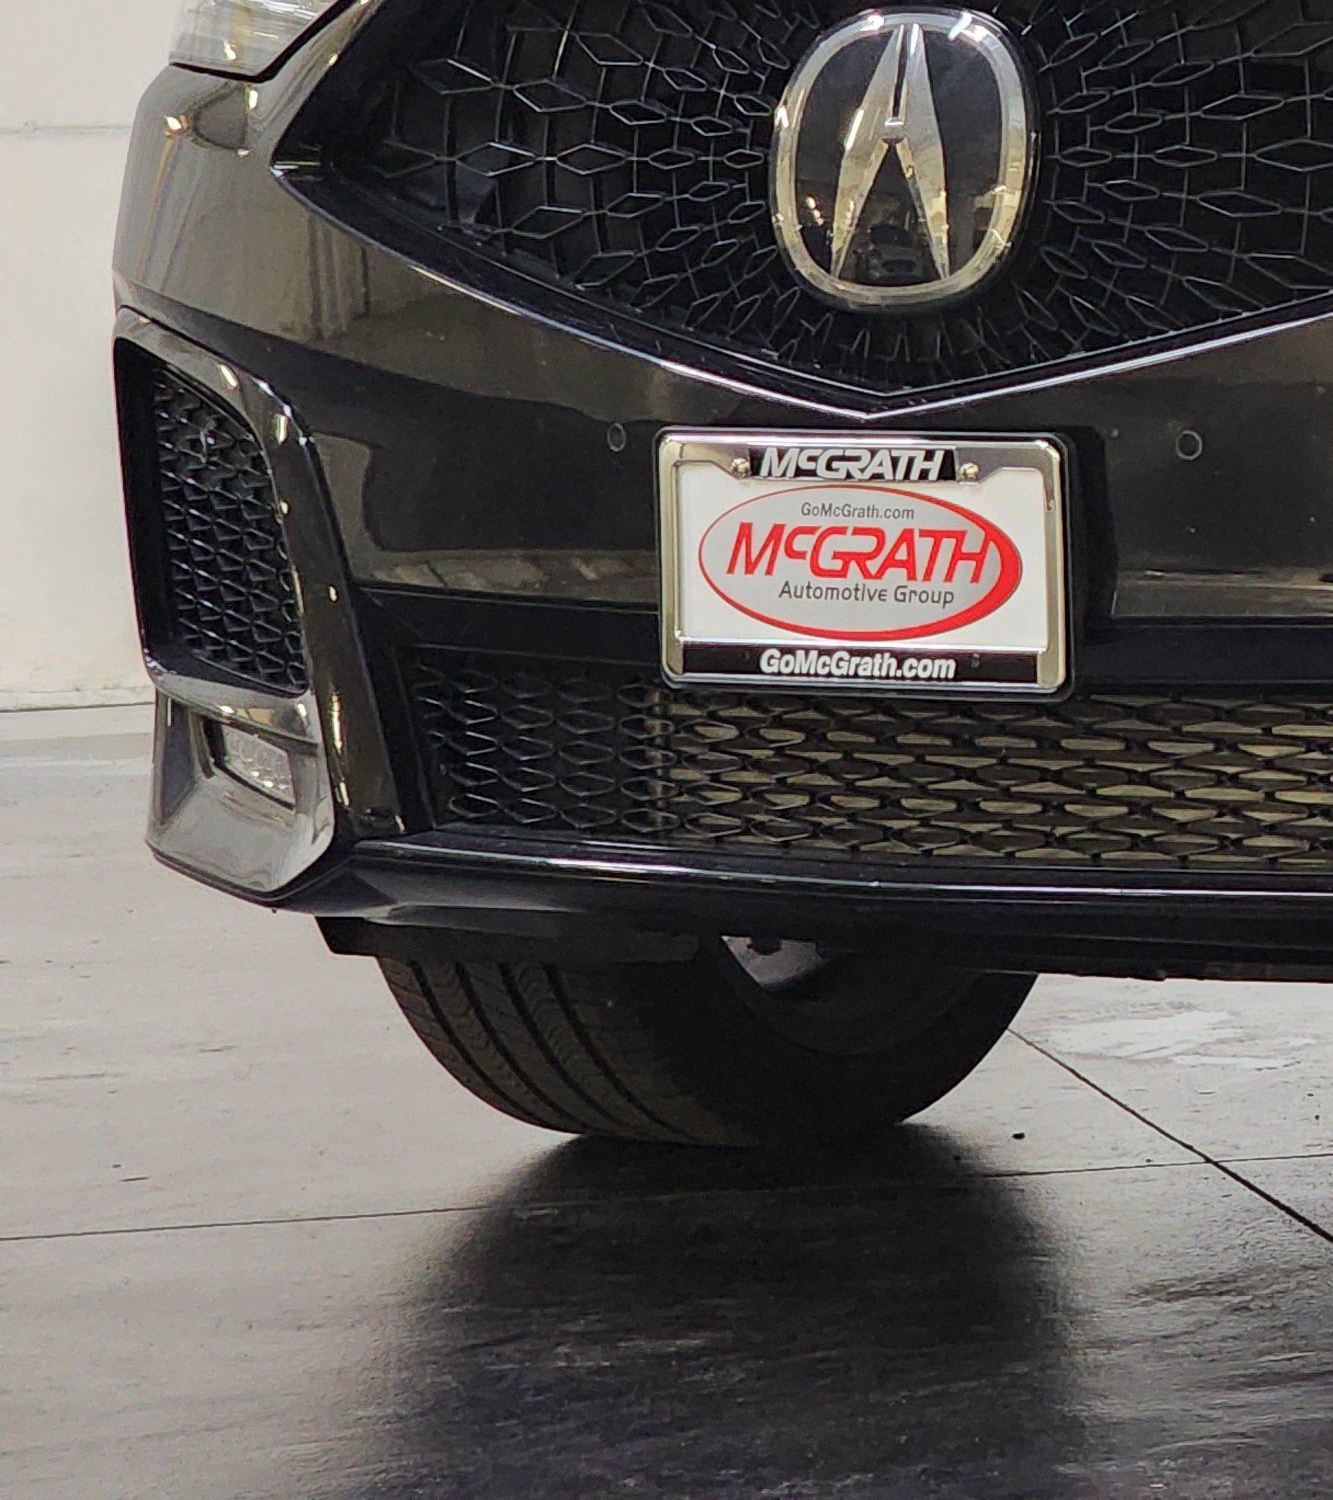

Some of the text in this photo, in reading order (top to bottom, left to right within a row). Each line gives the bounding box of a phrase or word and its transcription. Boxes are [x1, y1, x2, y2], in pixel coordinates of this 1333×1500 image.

[800, 501, 915, 520] GoMcGrath.com
[778, 580, 955, 609] Automotive Group
[760, 648, 956, 679] GoMcGrath.com
